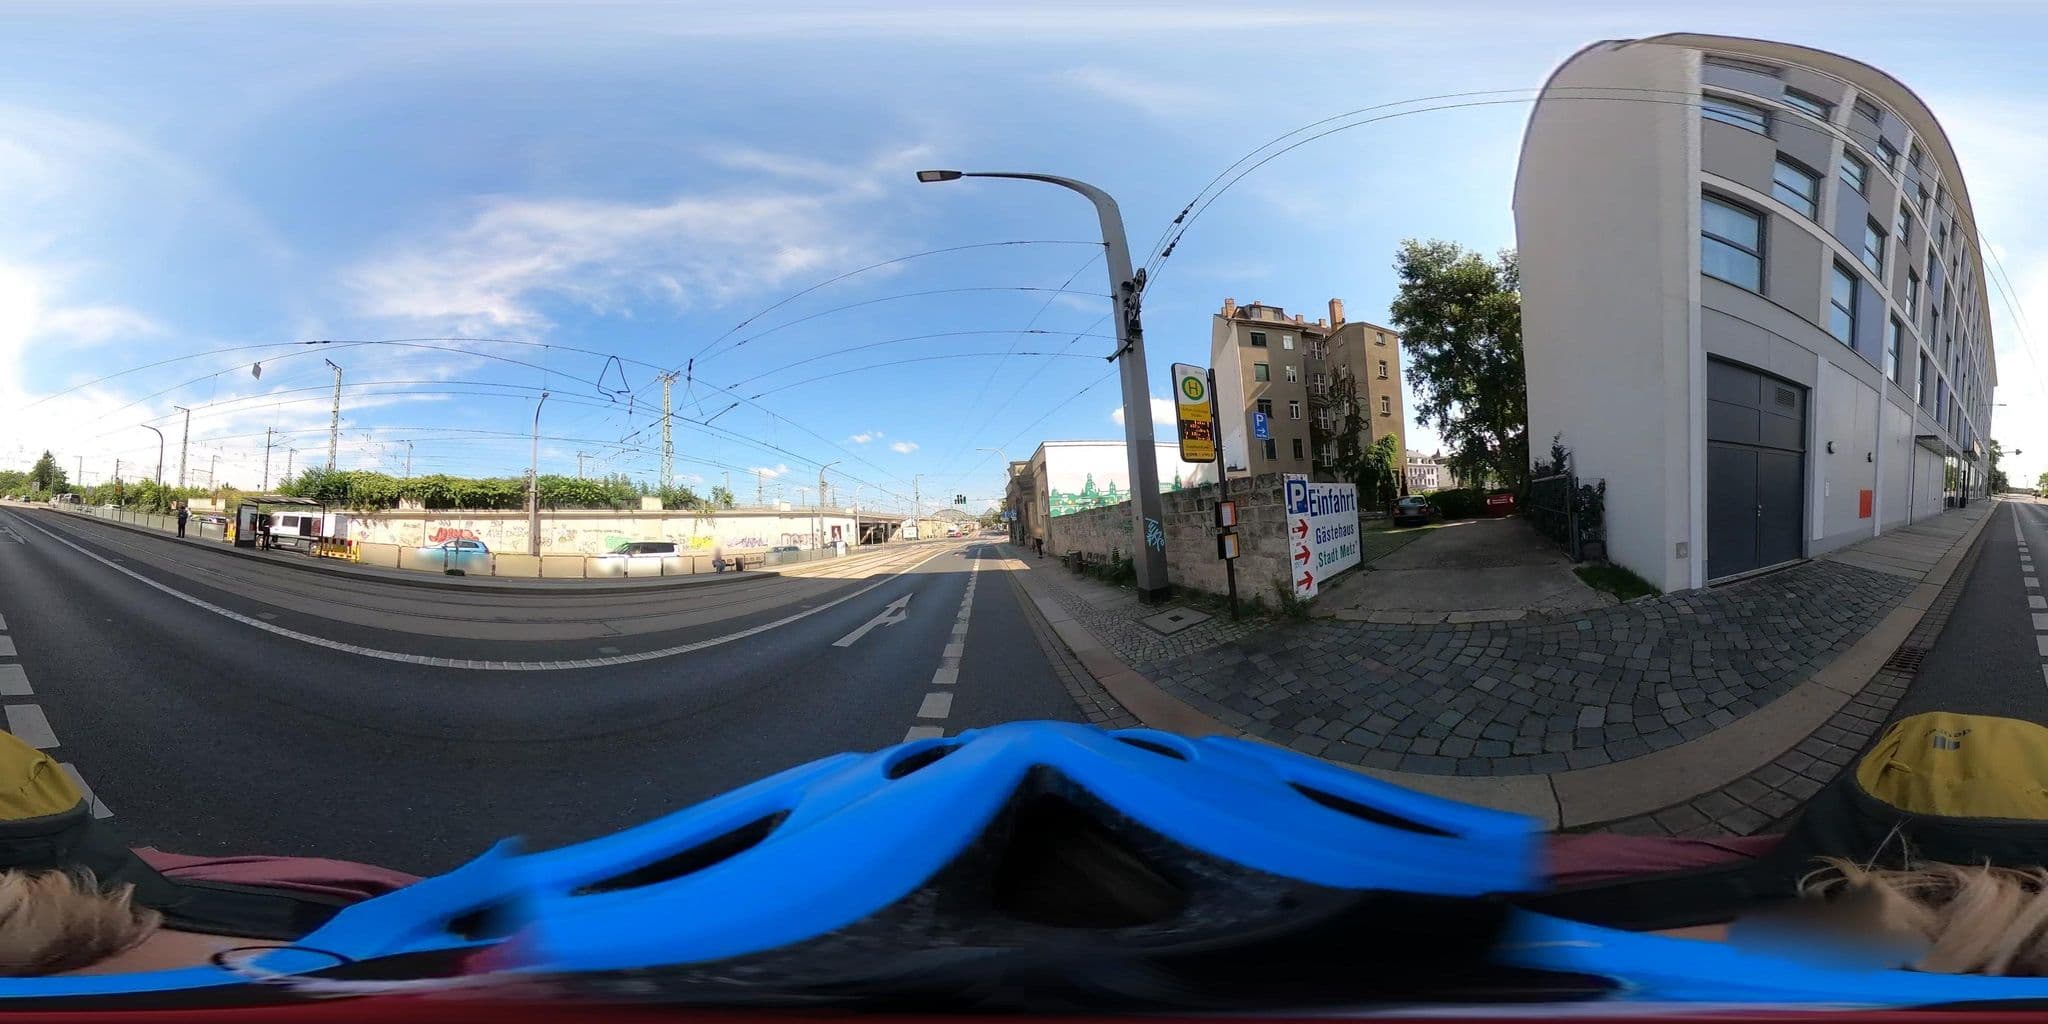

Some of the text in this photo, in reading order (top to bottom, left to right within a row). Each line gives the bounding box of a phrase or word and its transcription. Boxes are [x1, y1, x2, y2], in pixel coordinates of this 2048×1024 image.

[1188, 381, 1199, 396] H
[1256, 414, 1264, 426] P
[1290, 483, 1355, 517] P Einfahrt
[1316, 523, 1354, 545] Gästehaus
